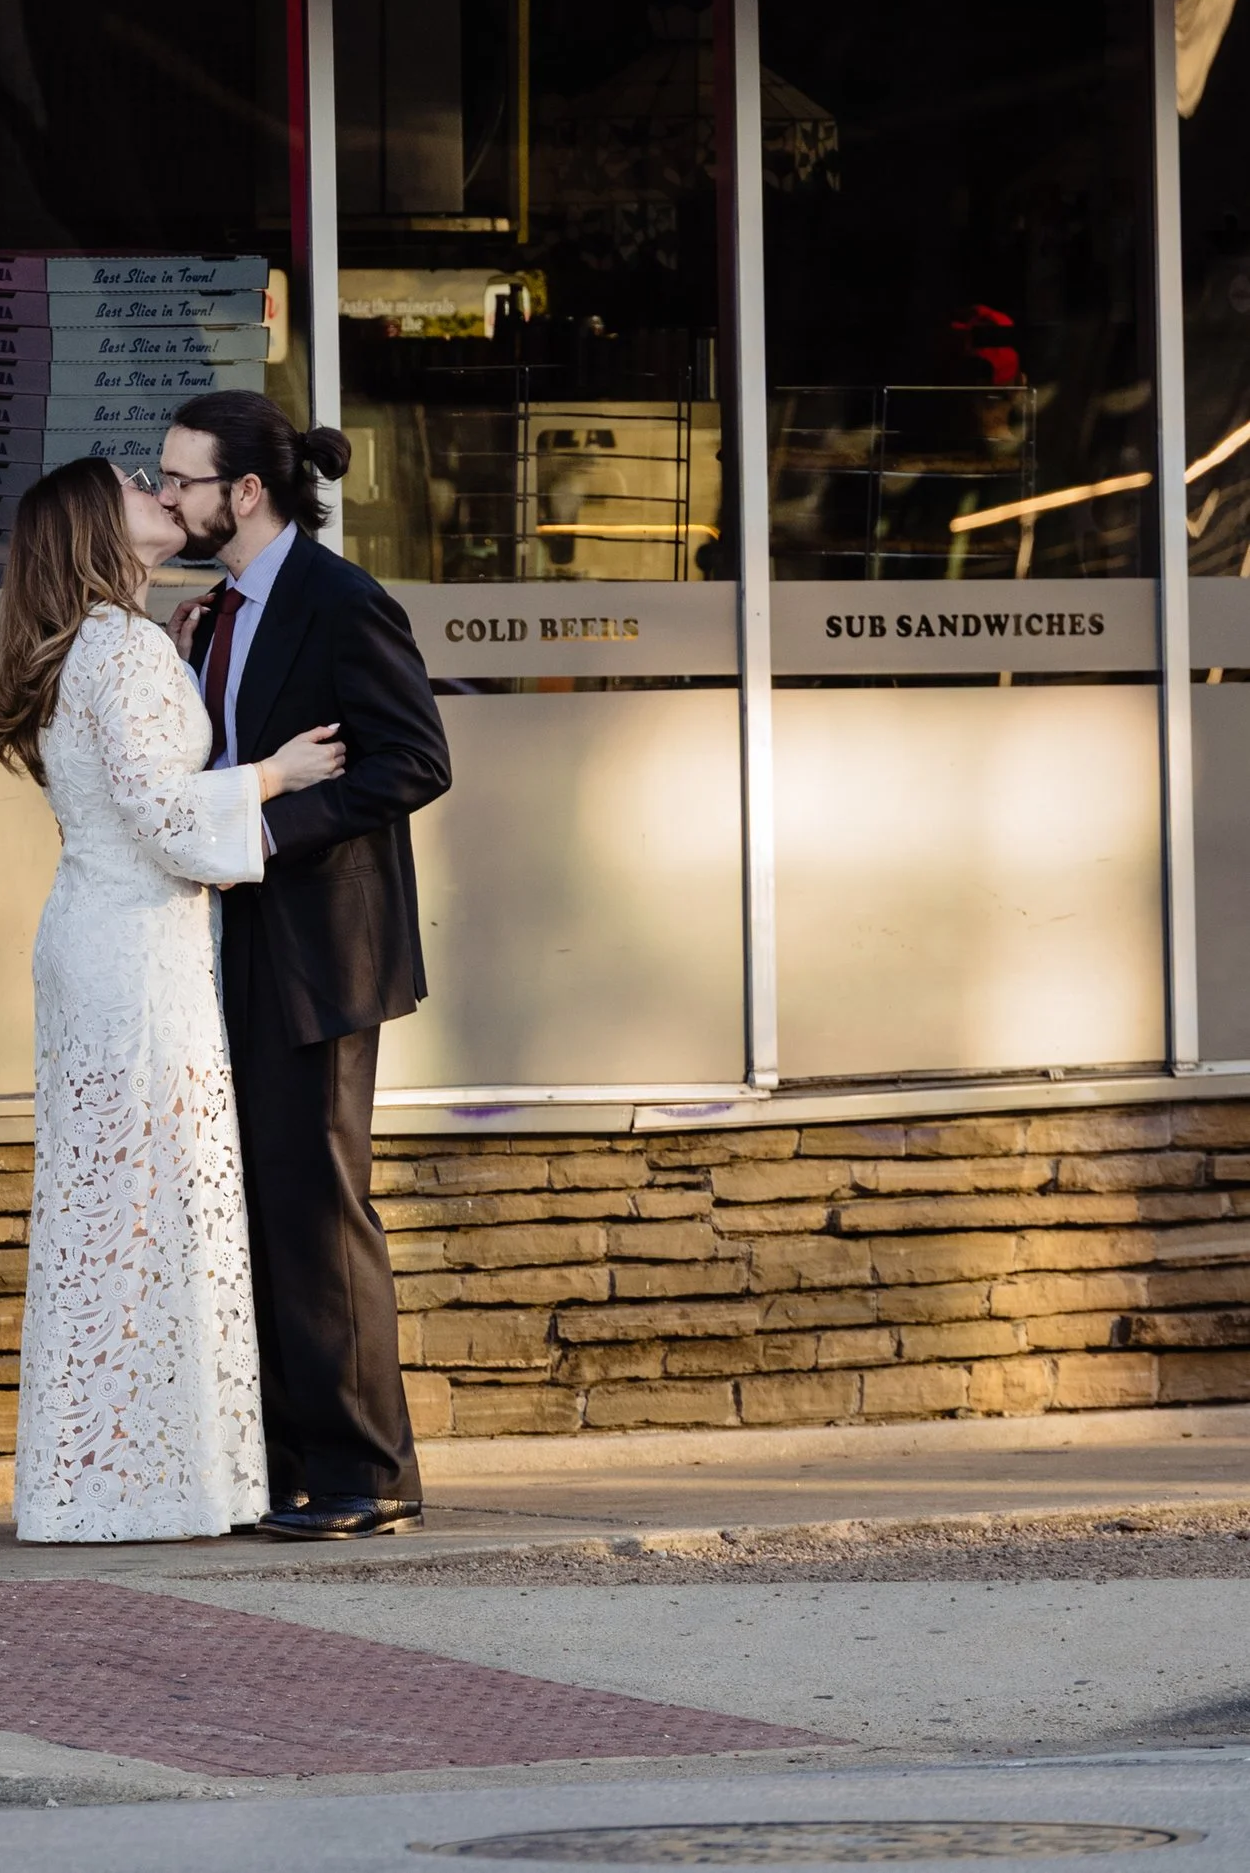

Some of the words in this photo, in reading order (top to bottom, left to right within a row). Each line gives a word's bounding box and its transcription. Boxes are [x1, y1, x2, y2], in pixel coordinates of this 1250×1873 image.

[93, 268, 121, 284] Best
[124, 268, 156, 284] Slice
[161, 271, 173, 283] in
[178, 267, 216, 283] Town!
[95, 302, 123, 318] Best
[125, 302, 157, 317] Slice
[162, 304, 173, 317] in
[178, 300, 215, 317] Town!
[98, 338, 126, 353] Best
[128, 338, 161, 353] Slice
[165, 340, 177, 353] in
[182, 336, 219, 353] Town!
[94, 371, 122, 387] Best
[124, 371, 156, 387] Slice
[161, 374, 173, 386] in
[177, 370, 215, 386] Town!
[93, 406, 121, 421] Best
[123, 406, 156, 421] Slice
[89, 440, 117, 456] Best
[119, 440, 151, 456] Slice
[445, 619, 528, 642] COLD
[539, 617, 639, 642] BEERS
[826, 615, 887, 638] SUB
[896, 614, 1105, 638] SANDWICHES
